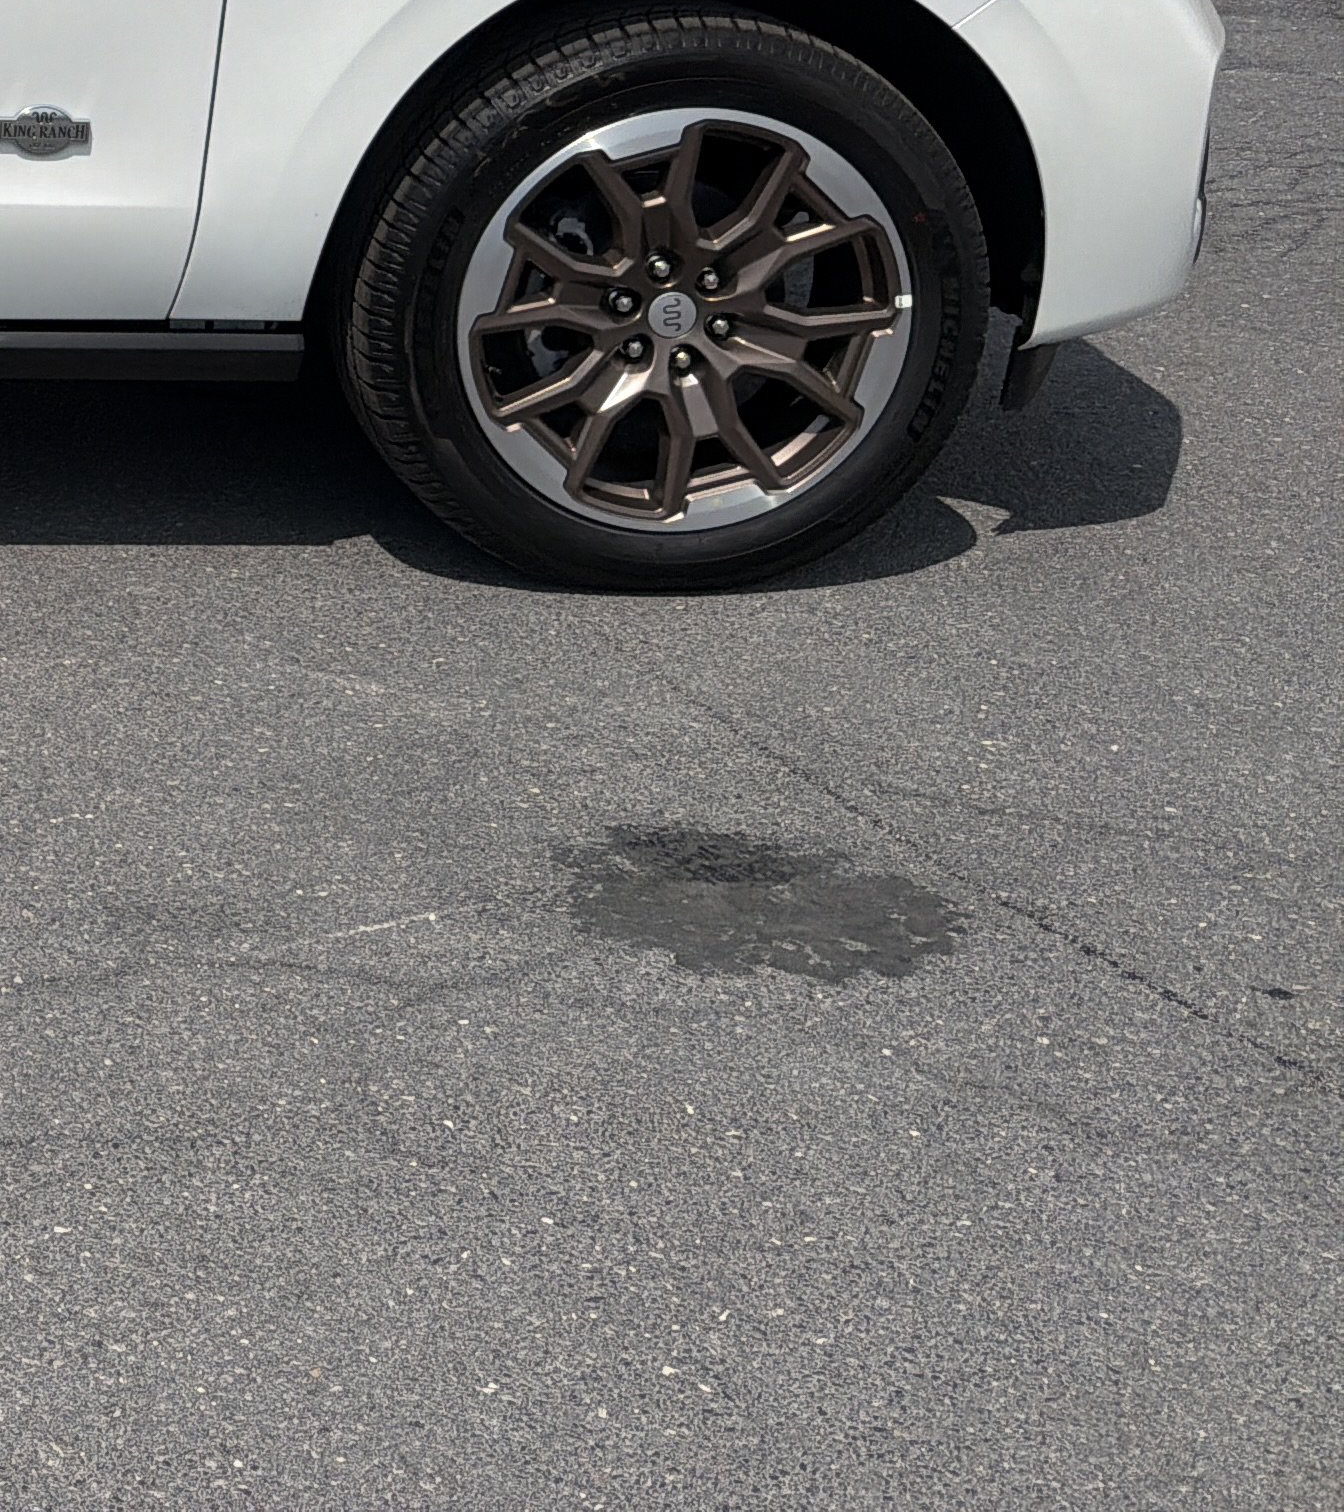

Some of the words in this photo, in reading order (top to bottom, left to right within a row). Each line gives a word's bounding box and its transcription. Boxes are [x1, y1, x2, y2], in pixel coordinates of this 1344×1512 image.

[3, 122, 36, 138] KING
[39, 124, 86, 139] RANCH
[910, 276, 960, 439] MICHELIN
